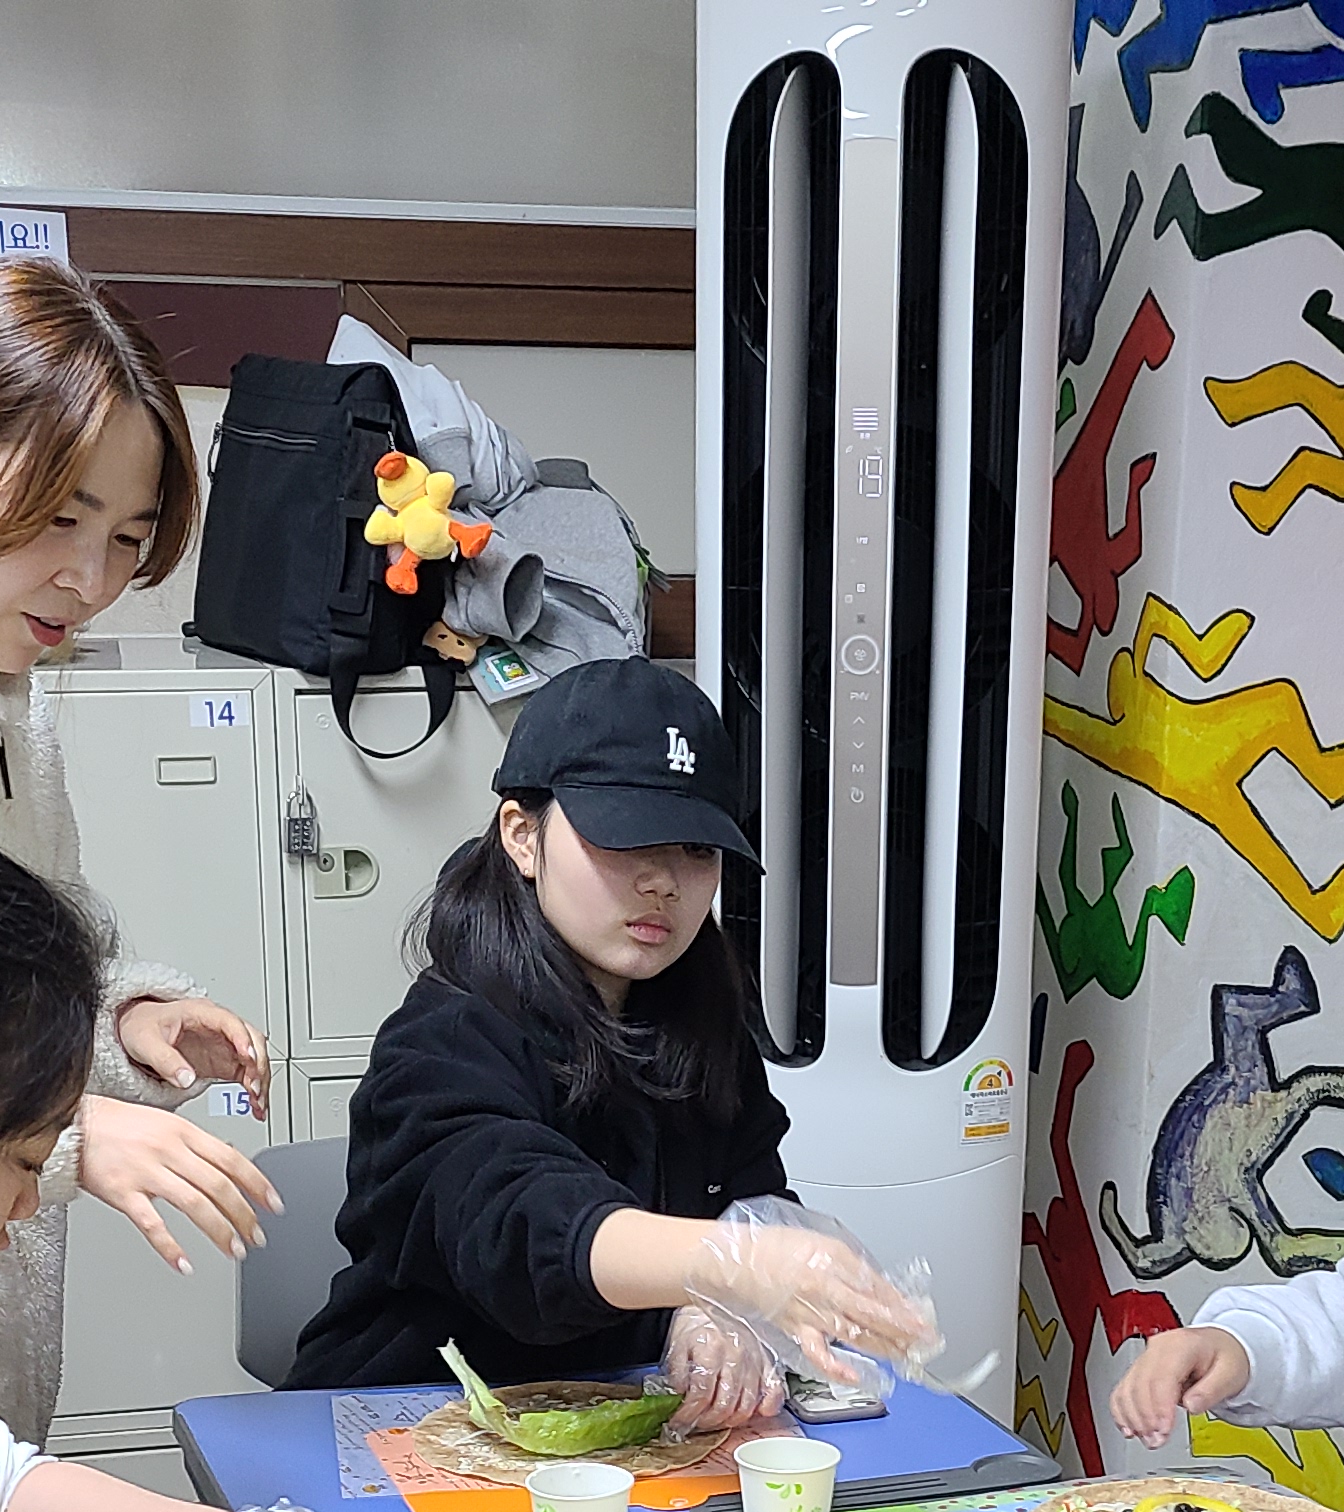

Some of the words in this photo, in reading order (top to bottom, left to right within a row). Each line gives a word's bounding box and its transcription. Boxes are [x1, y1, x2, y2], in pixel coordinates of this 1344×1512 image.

[858, 455, 884, 499] 19
[204, 700, 236, 728] 14
[666, 726, 696, 775] LA
[222, 1091, 251, 1116] 15
